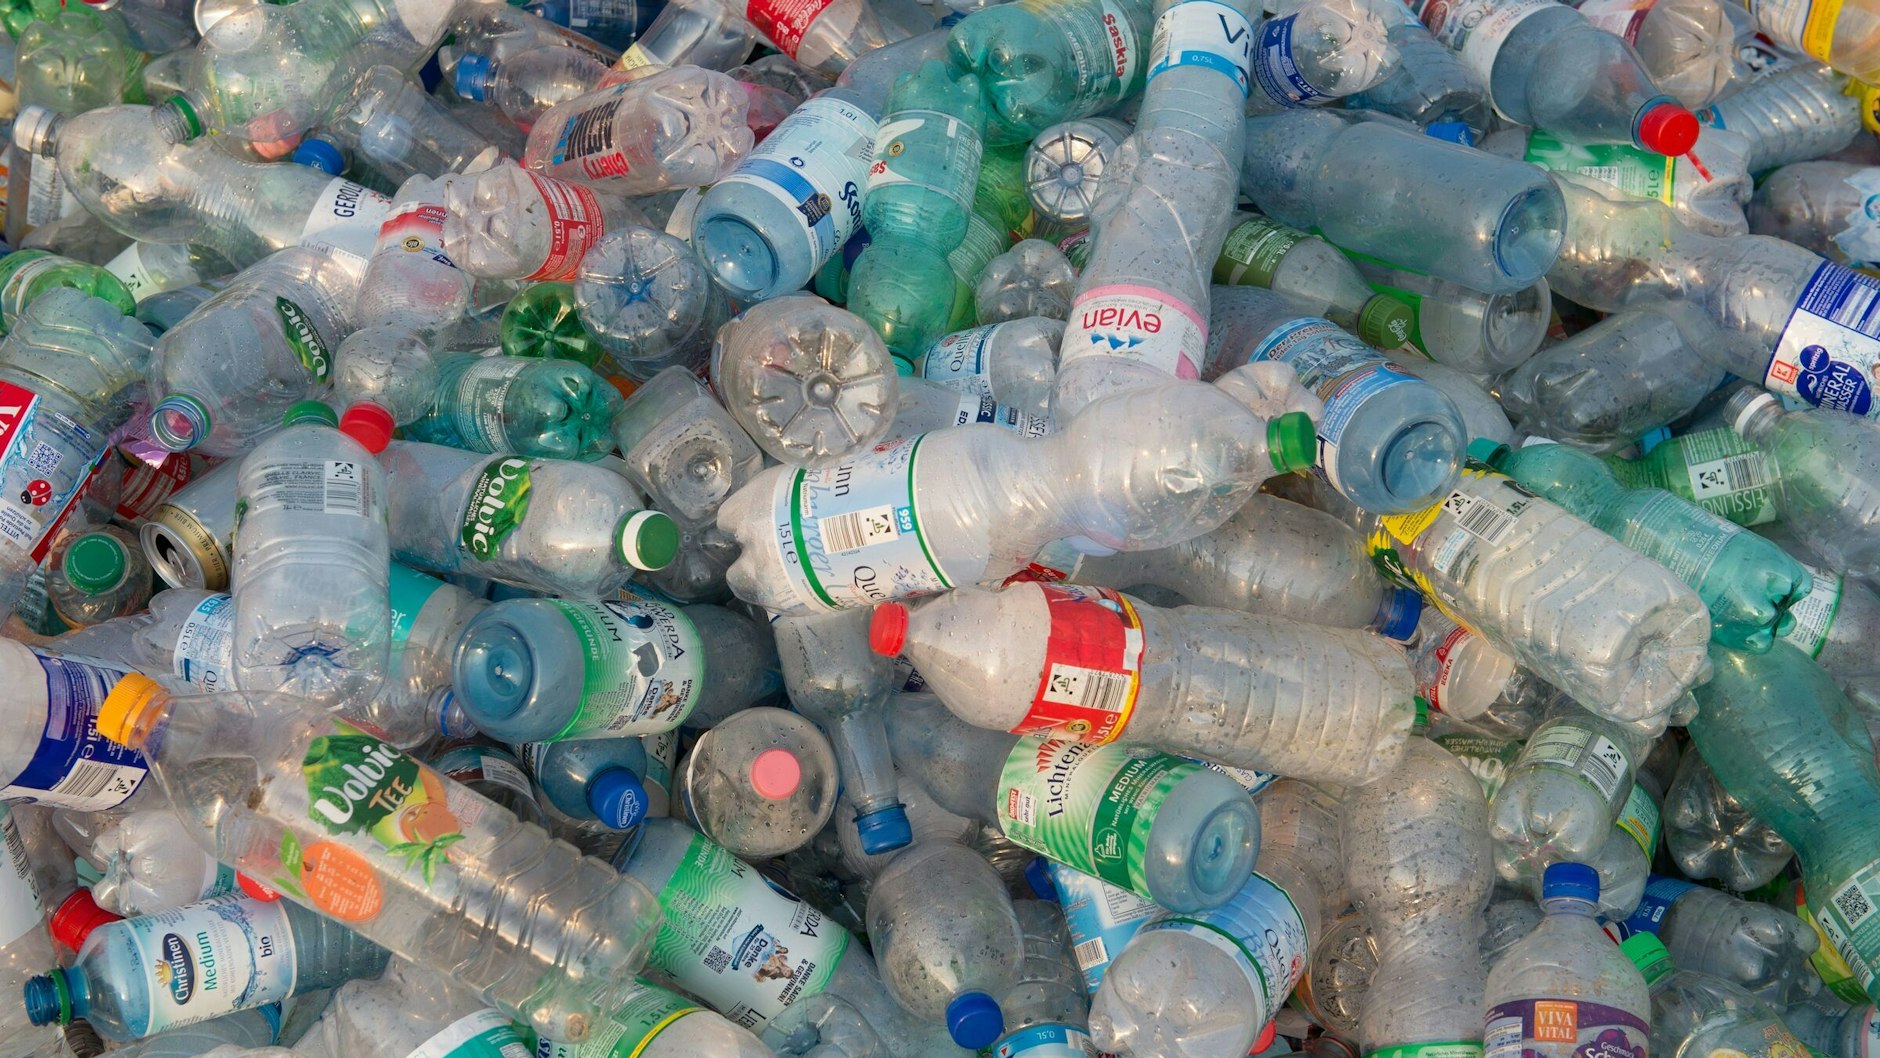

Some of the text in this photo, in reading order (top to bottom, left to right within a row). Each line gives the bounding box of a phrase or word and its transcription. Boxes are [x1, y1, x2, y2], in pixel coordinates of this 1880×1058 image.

[1102, 13, 1127, 79] saskia
[1217, 12, 1250, 57] Vi
[1066, 31, 1087, 87] MEDIUM
[583, 151, 629, 180] cherry
[281, 303, 327, 376] Volvic
[1083, 307, 1162, 333] evian
[1808, 347, 1824, 370] spritzig
[472, 458, 527, 553] Volvic
[900, 508, 912, 530] 959
[853, 565, 886, 598] Que
[314, 743, 402, 824] Volvic
[368, 775, 413, 812] TEE
[1109, 759, 1148, 803] MEDIUM
[1024, 796, 1032, 808] gut
[196, 931, 218, 991] Medium
[260, 935, 273, 958] bio
[744, 938, 768, 968] Danke
[169, 936, 190, 1001] Christinen
[778, 965, 804, 1004] GEWINNEN!
[784, 962, 816, 1008] DANKE SAGEN
[1538, 1010, 1574, 1027] VIVA
